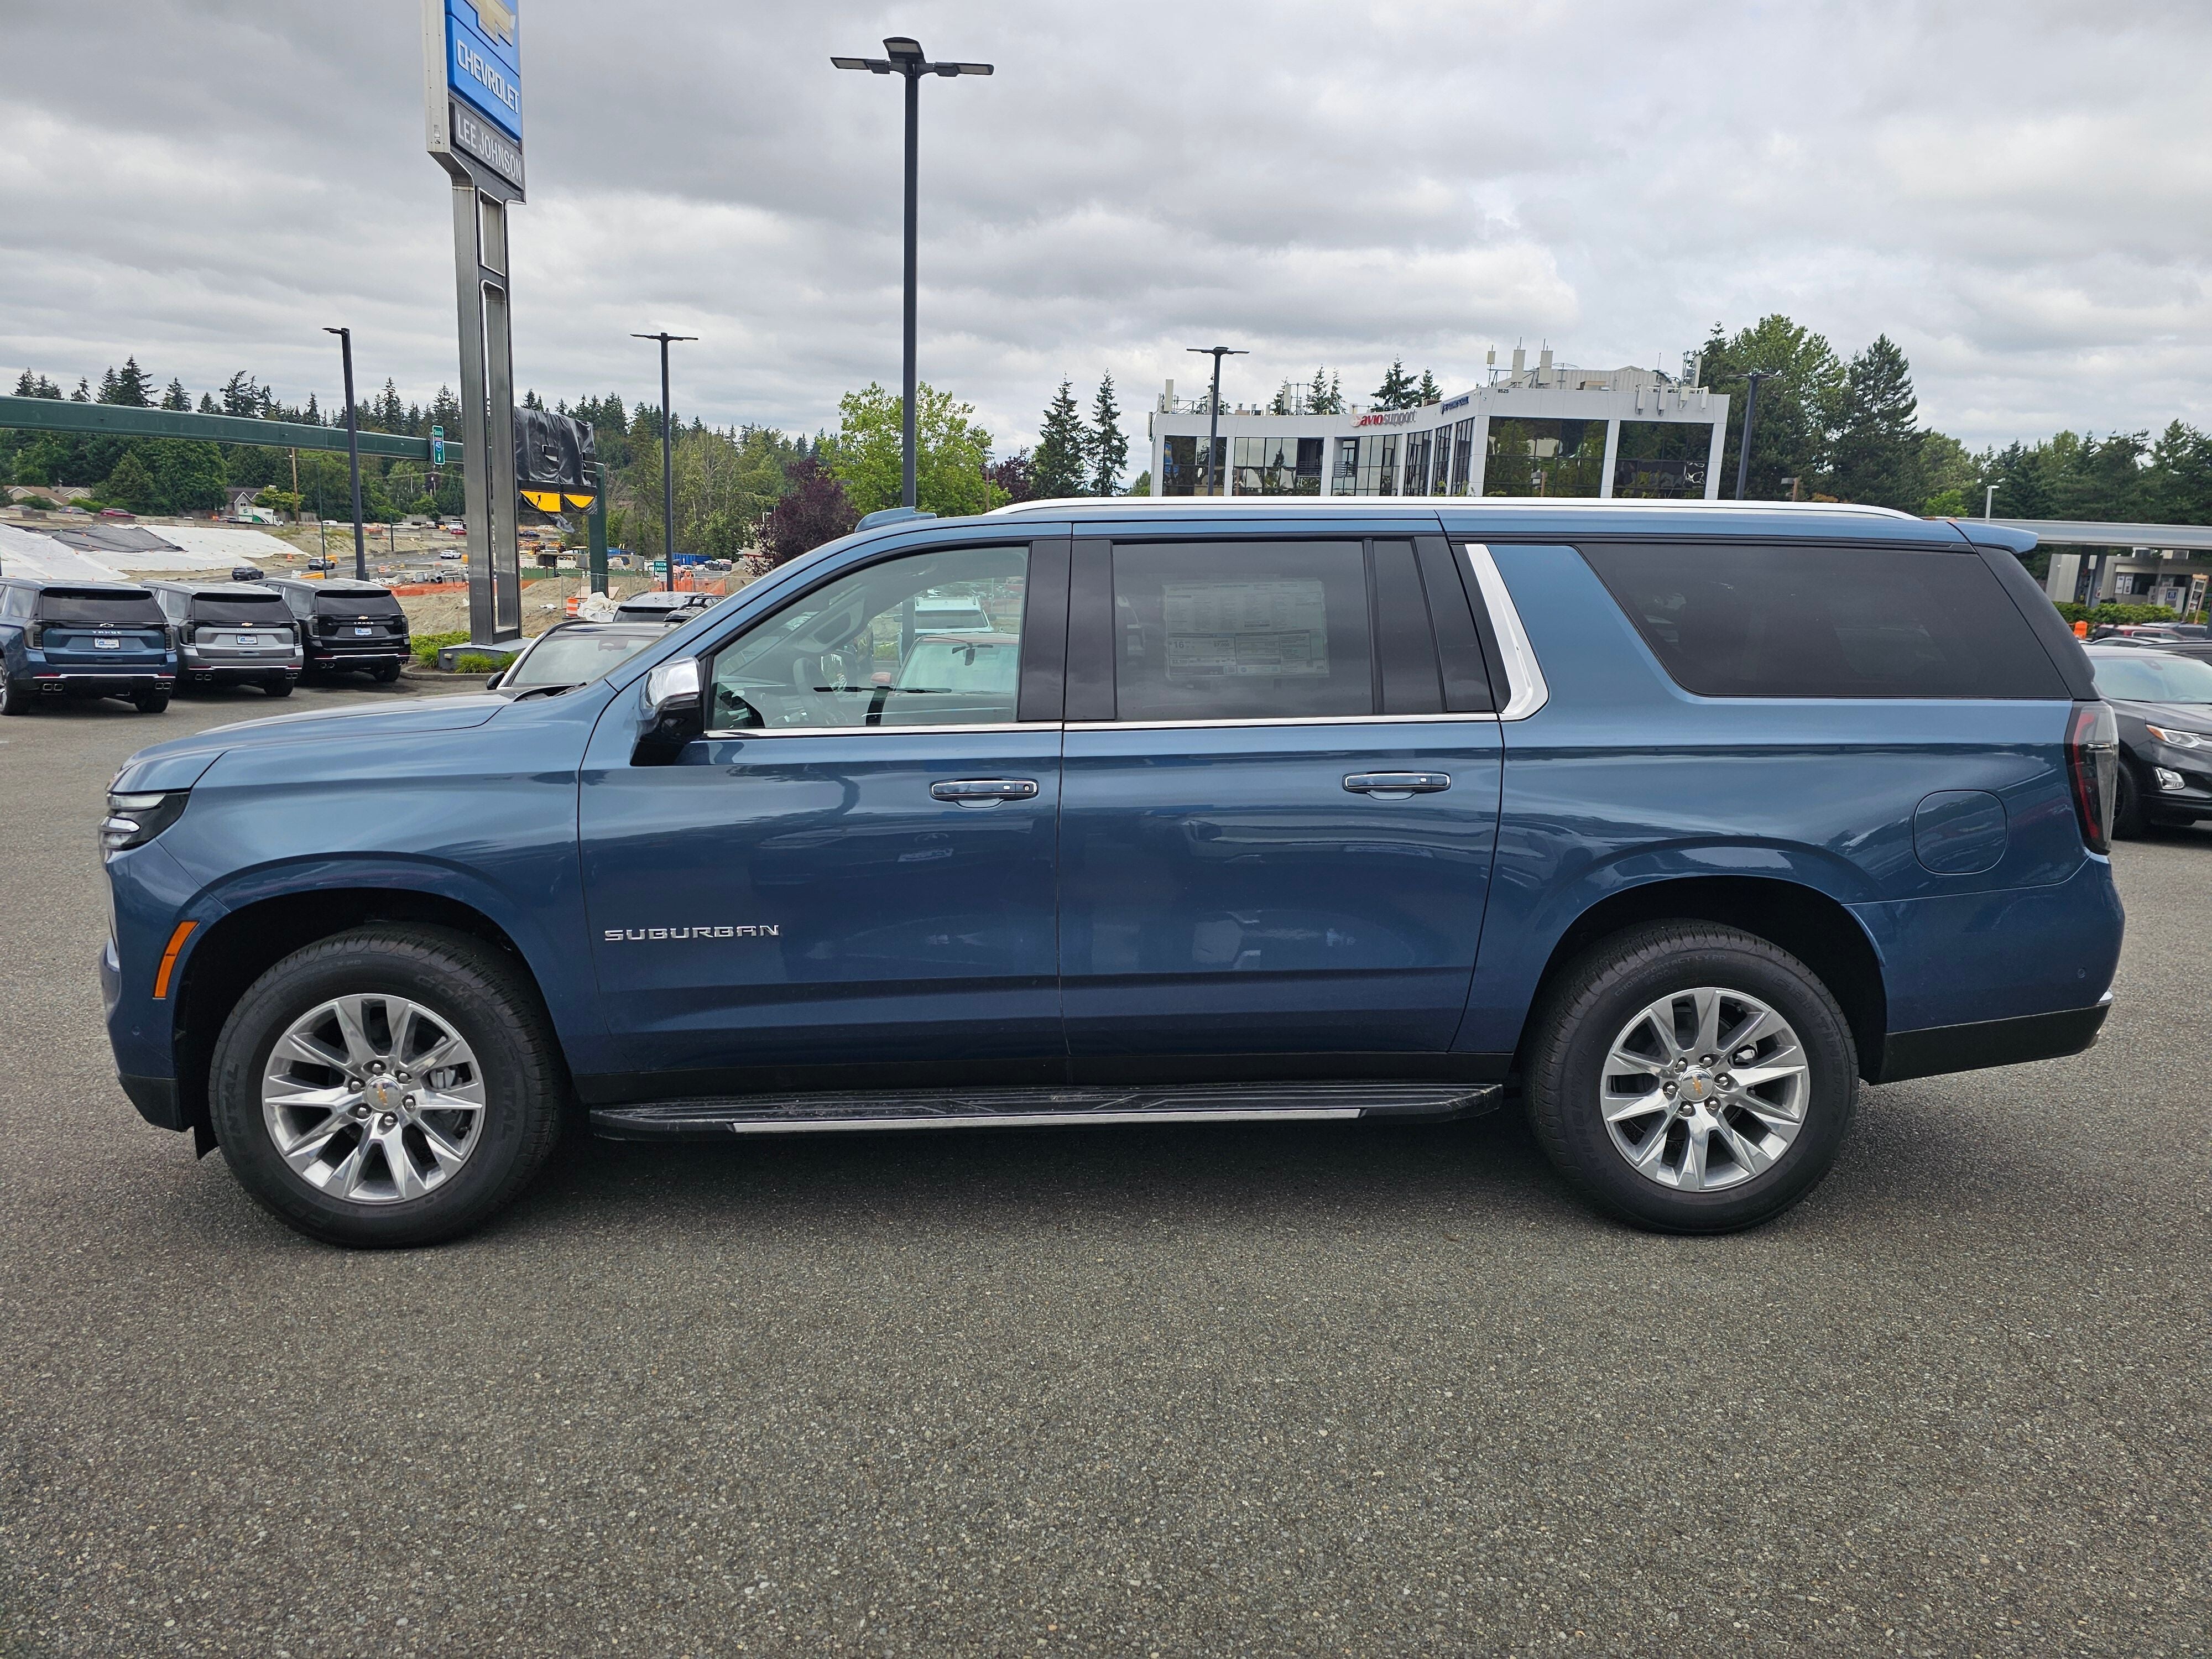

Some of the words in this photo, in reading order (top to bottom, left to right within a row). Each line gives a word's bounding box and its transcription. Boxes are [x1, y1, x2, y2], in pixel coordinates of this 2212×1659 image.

[457, 39, 519, 114] CHEVROLET
[457, 113, 477, 150] LEE
[479, 132, 521, 182] JOHNSON
[605, 925, 779, 941] SUBURBAN
